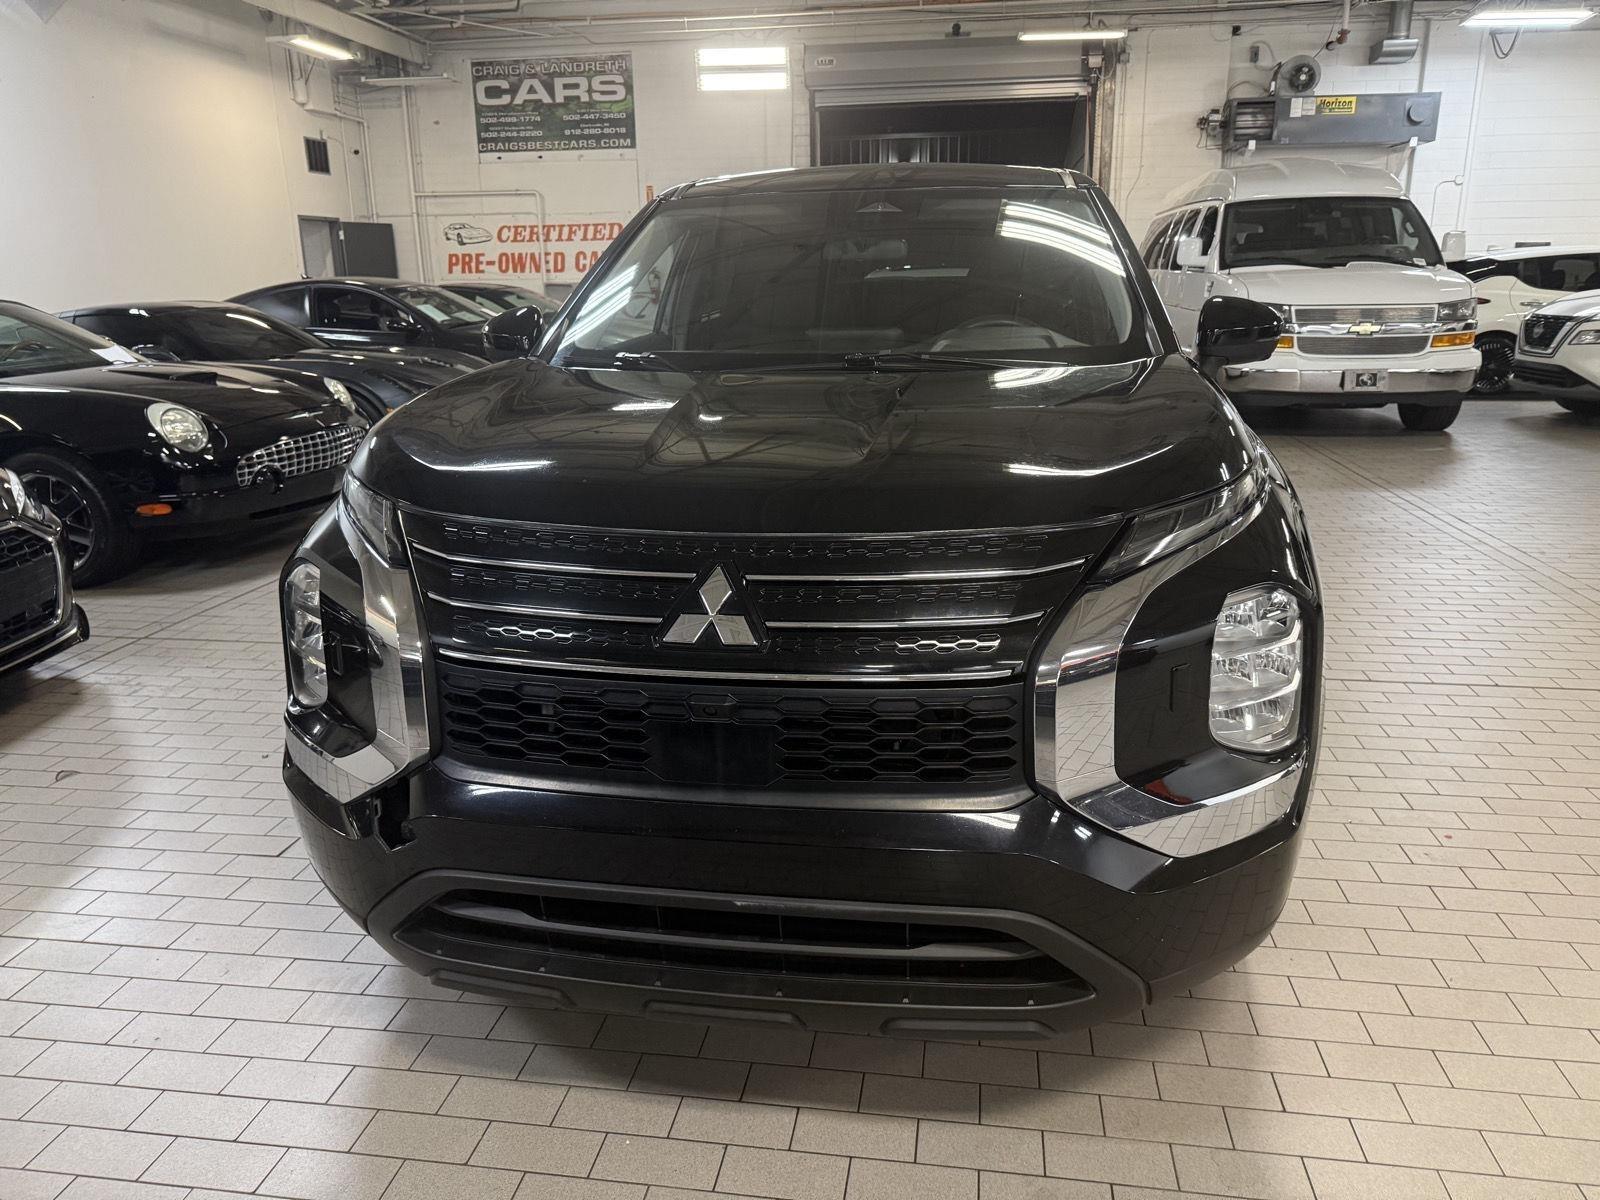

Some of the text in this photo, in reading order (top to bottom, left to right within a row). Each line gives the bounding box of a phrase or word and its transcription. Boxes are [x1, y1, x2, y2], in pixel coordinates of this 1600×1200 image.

[472, 60, 626, 77] CRAIG & LANDRETH
[475, 75, 626, 106] CARS
[1320, 98, 1352, 107] Horizon
[479, 138, 631, 151] CRAIGSBESTCARS.COM
[496, 222, 624, 243] CERTIFIED
[447, 250, 603, 274] PRE-OWNED CA
